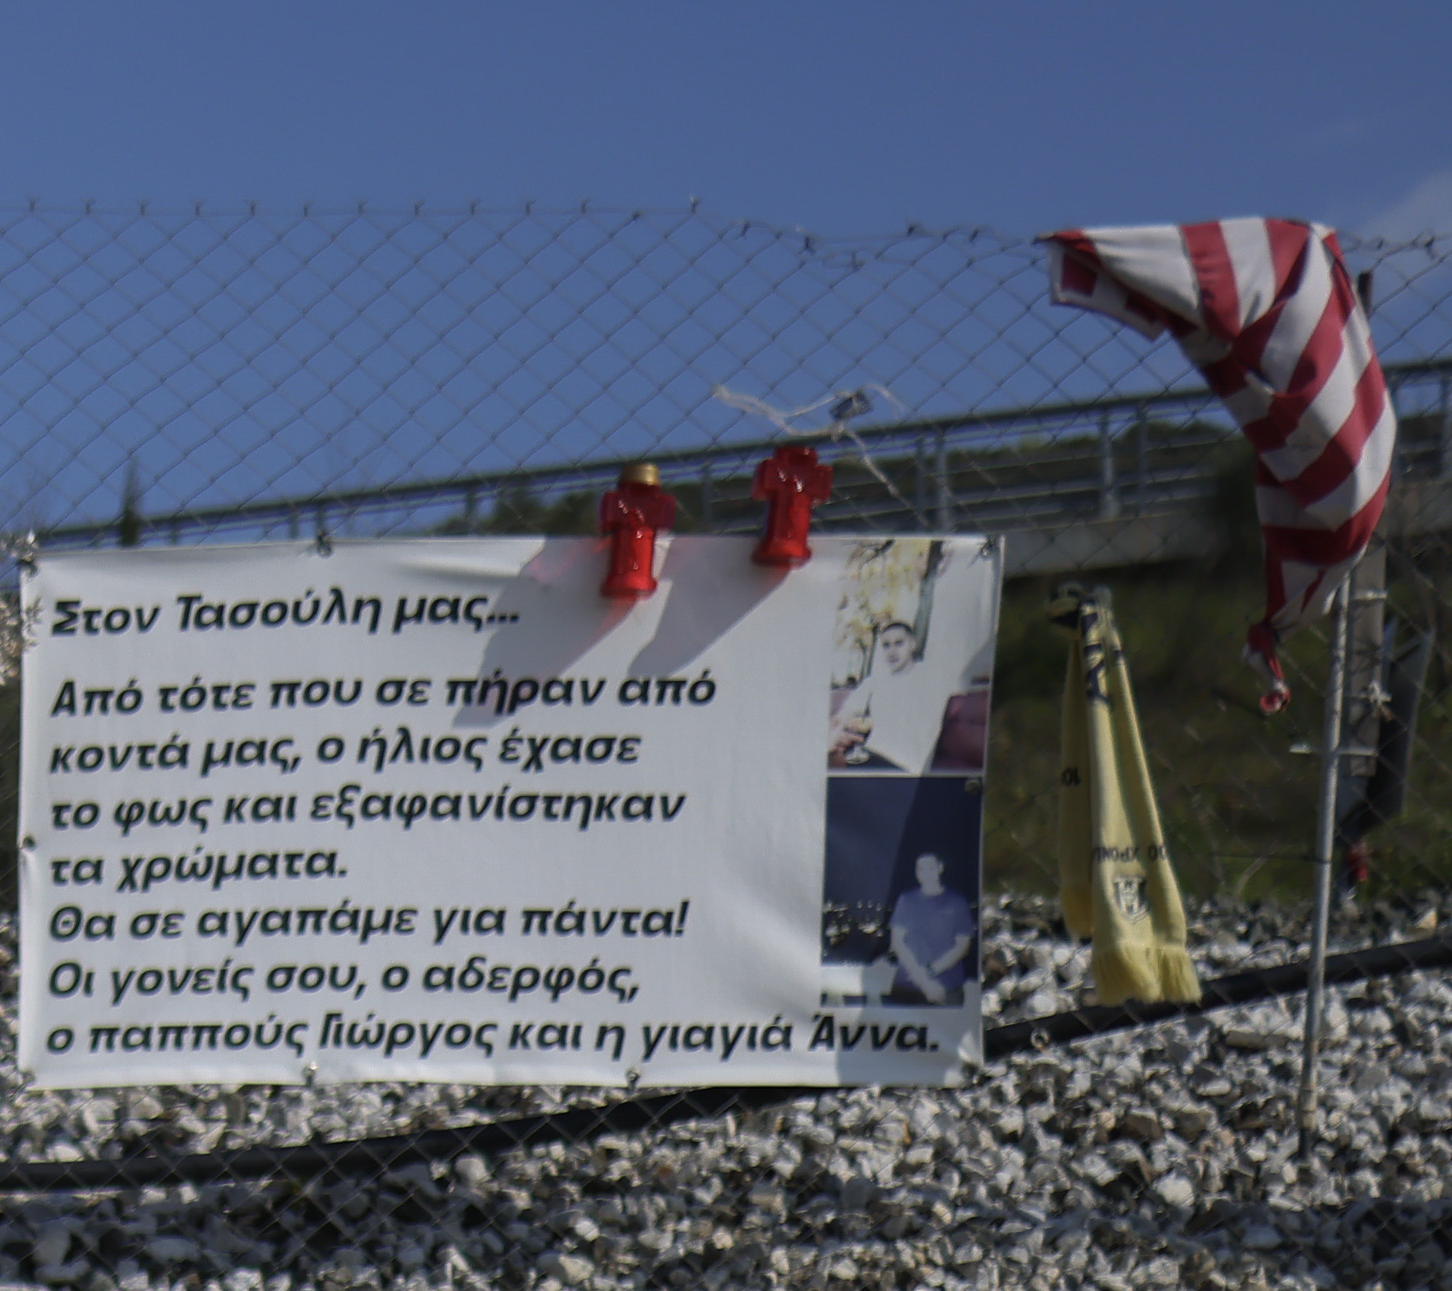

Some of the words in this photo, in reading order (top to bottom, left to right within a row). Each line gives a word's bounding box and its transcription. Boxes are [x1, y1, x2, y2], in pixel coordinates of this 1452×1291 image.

[52, 600, 160, 635] Στον
[177, 587, 382, 634] Τασούλη
[392, 596, 520, 634] μας...
[51, 679, 143, 716] Από
[158, 676, 256, 712] τότε
[270, 679, 362, 708] που
[376, 679, 431, 705] σε
[447, 668, 606, 716] πήραν
[618, 669, 716, 705] από
[50, 734, 190, 773] κοντά
[201, 738, 301, 777] μας,
[317, 737, 345, 763] ο
[357, 727, 487, 772] ήλιος
[499, 728, 642, 772] έχασε
[52, 802, 100, 829] το
[114, 798, 212, 836] φως
[224, 796, 297, 823] και
[310, 784, 687, 831] εξαφανίστηκαν
[51, 859, 104, 885] τα
[117, 847, 347, 892] χρώματα.
[50, 906, 116, 941] Θα
[130, 912, 184, 939] σε
[197, 899, 418, 946] αγαπάμε
[434, 909, 506, 945] για
[522, 899, 690, 937] πάντα!
[49, 962, 94, 998] Οι
[111, 959, 254, 1006] γονείς
[266, 965, 366, 999] σου,
[381, 966, 409, 991] ο
[422, 956, 639, 1003] αδερφός,
[46, 1028, 75, 1054] ο
[90, 1014, 308, 1057] παππούς
[319, 1013, 498, 1058] Γιώργος
[509, 1024, 582, 1049] και
[595, 1025, 625, 1060] η
[642, 1014, 793, 1061] γιαγιά
[810, 1013, 939, 1052] Άννα.
